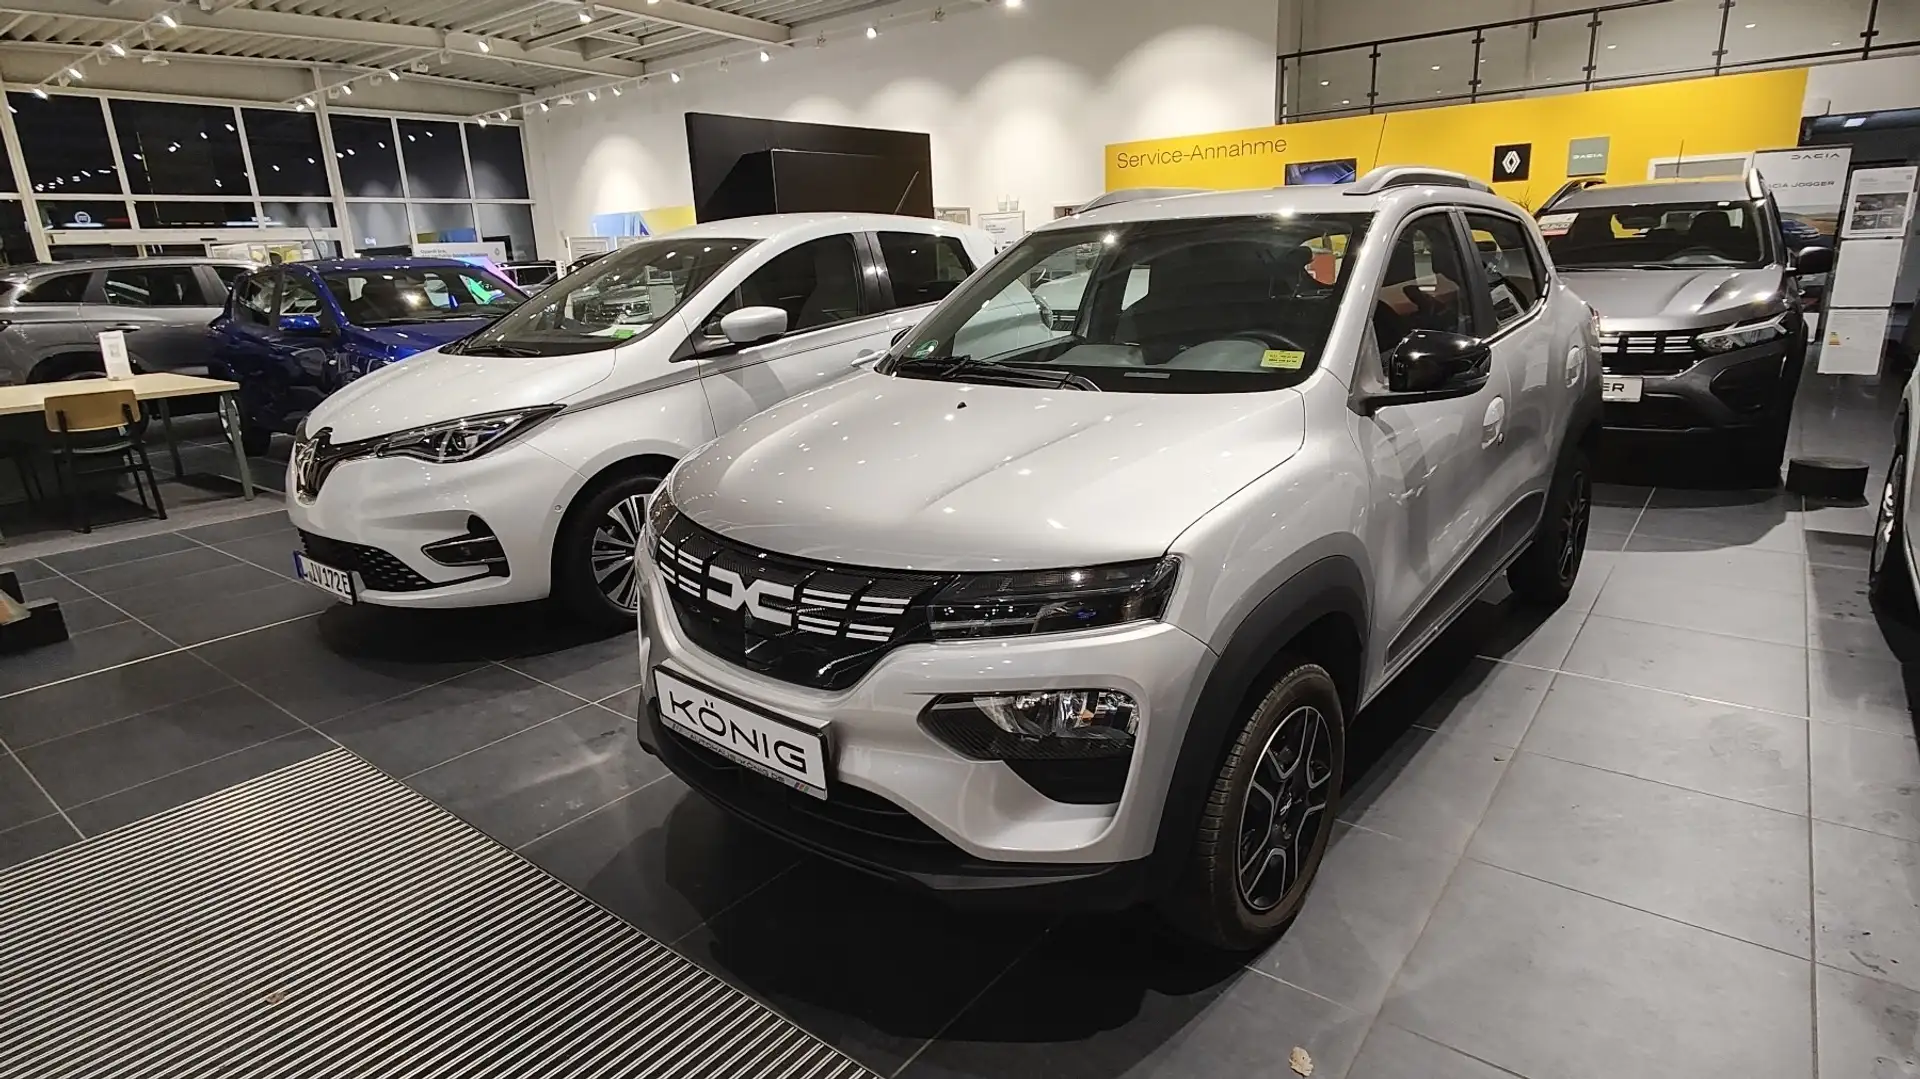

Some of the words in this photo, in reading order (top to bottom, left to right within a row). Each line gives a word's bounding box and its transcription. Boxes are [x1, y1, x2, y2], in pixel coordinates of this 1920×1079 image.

[1116, 138, 1288, 169] Service-Annahme
[1791, 152, 1840, 160] DACIA
[1791, 180, 1835, 188] JOGGER
[1603, 382, 1625, 392] ER
[669, 690, 808, 775] KÖNIG
